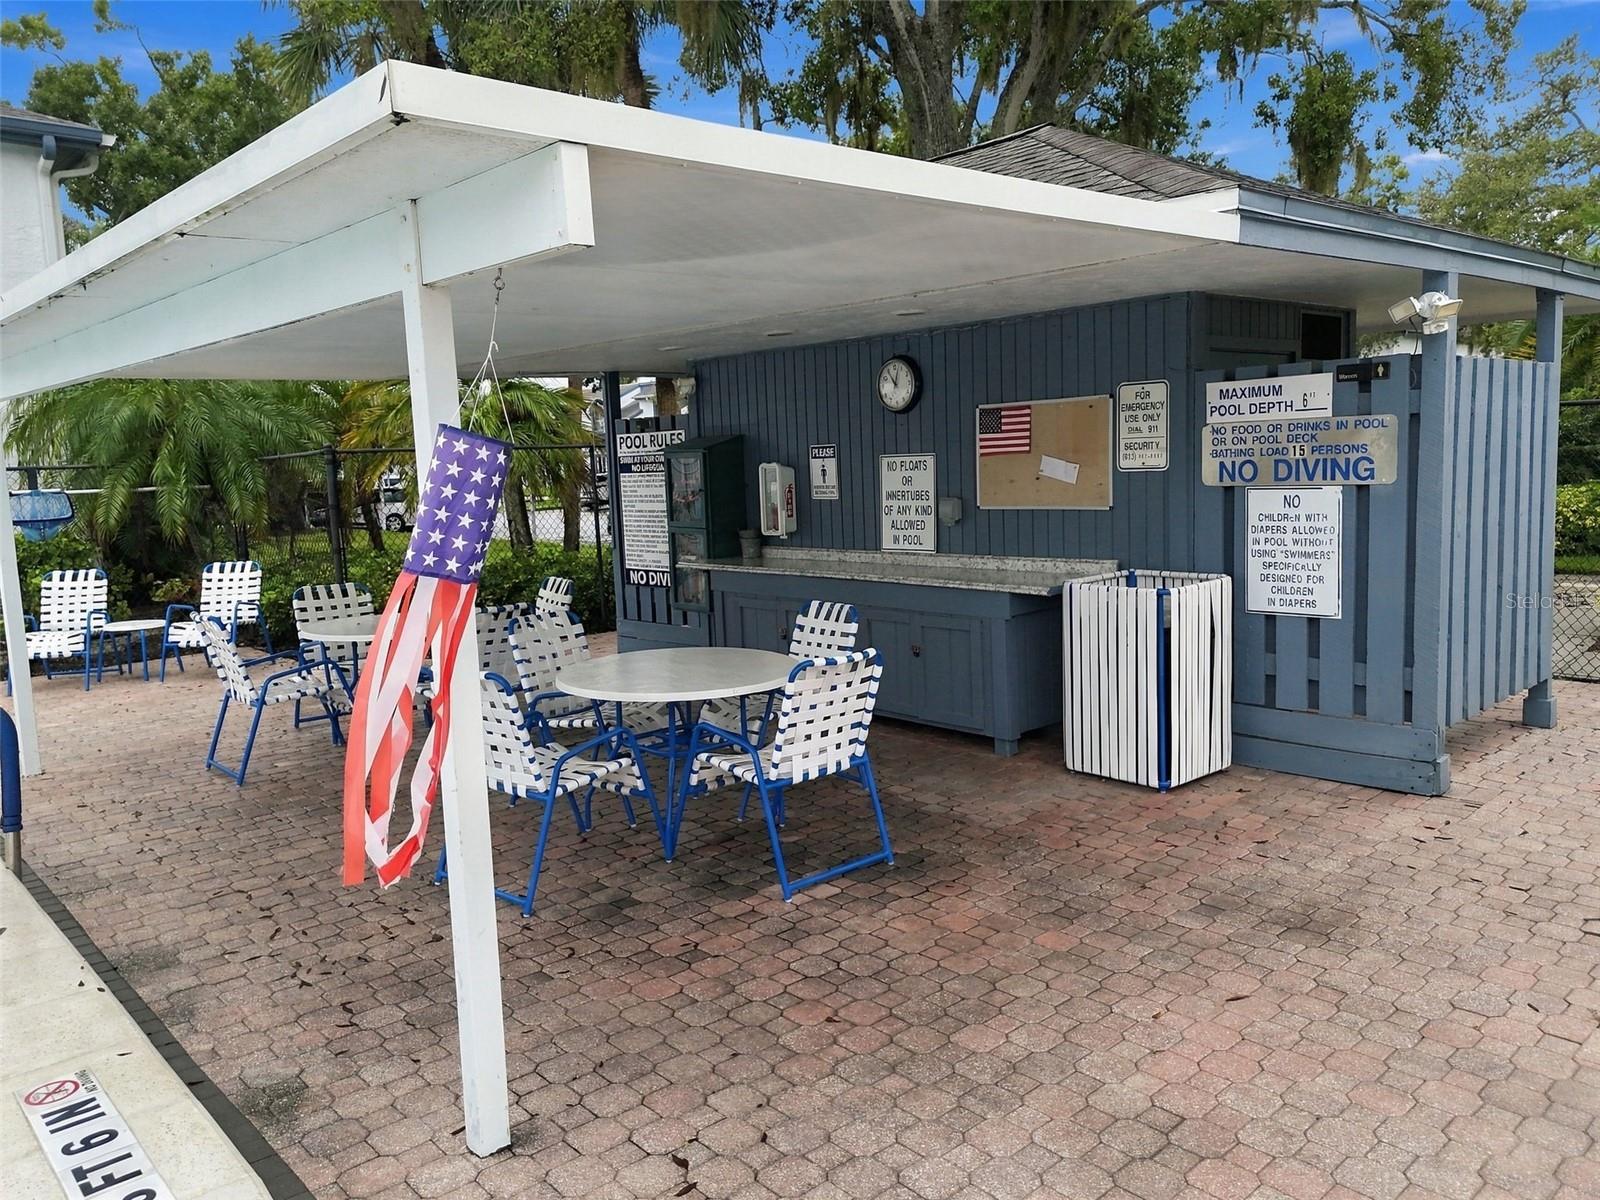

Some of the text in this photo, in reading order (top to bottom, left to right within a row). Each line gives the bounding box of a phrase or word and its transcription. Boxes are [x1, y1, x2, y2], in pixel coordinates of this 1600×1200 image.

[1135, 391, 1150, 400] FOR
[1219, 385, 1283, 400] MAXIMUM
[1121, 401, 1165, 412] EMERGENCY
[1210, 402, 1245, 417] POOL
[1249, 401, 1293, 414] DEPTH
[1124, 413, 1161, 423] USE ONLY
[1148, 425, 1159, 433] 911
[1212, 418, 1388, 436] NO FOOD OR DRINKS IN POOL
[620, 432, 683, 449] POOL RULES
[1212, 433, 1318, 446] OR ON POOL DECK
[1124, 441, 1160, 451] SECURITY
[1212, 444, 1368, 458] BATHING LOAD 15 PERSONS
[812, 447, 834, 457] PLEASE
[631, 463, 664, 472] NO LIFEGUA
[887, 460, 928, 472] NO FLOATS
[1218, 456, 1375, 483] NO DIVING
[902, 476, 912, 486] OR
[886, 490, 930, 501] INNERTUBES
[1283, 495, 1301, 509] NO
[884, 505, 932, 516] OF ANY KIND
[1258, 513, 1327, 522] CHILDREN WITH
[891, 520, 926, 531] ALLOWED
[1251, 525, 1287, 535] DIAPERS
[893, 535, 923, 545] IN POOL
[1252, 537, 1334, 546] IN POOL WITHOUT
[1251, 549, 1276, 559] USING
[1262, 561, 1322, 571] SPECIFICALLY
[629, 570, 671, 586] NO DIVI
[1260, 573, 1324, 584] DESIGNED FOR
[1271, 586, 1314, 596] CHILDREN
[1267, 598, 1317, 608] IN DIAPERS
[40, 1096, 107, 1135] IN
[60, 1128, 119, 1156] 6
[71, 1152, 143, 1198] FT
